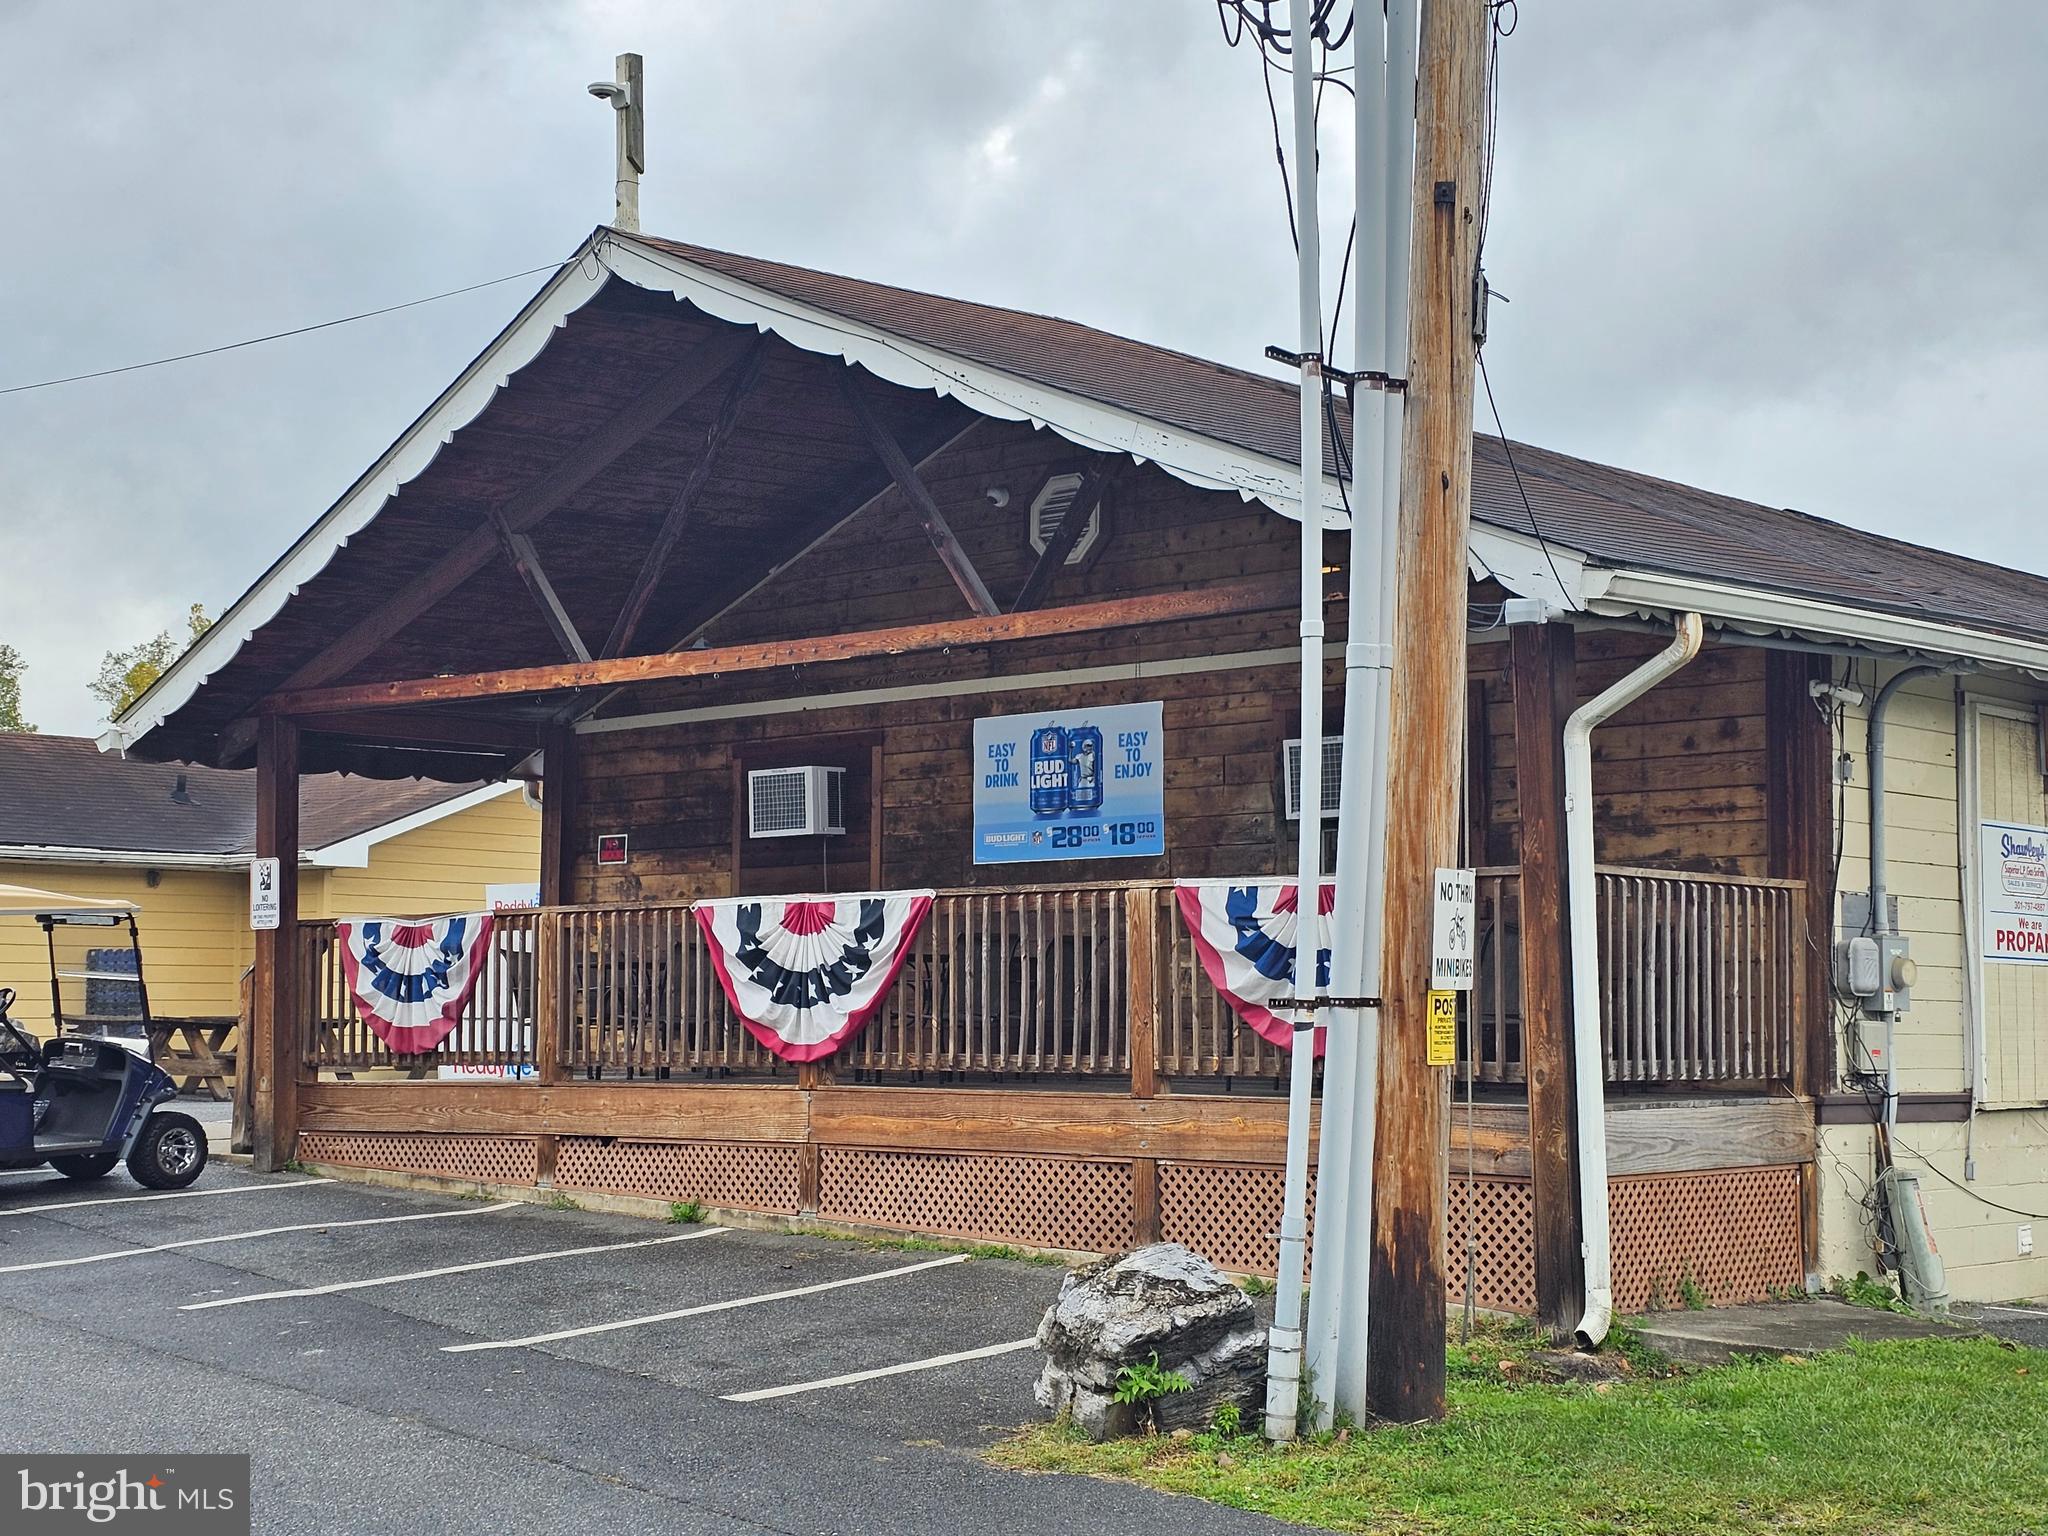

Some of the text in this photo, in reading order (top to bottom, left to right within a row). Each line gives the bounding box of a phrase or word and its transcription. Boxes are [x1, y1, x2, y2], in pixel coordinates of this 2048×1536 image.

[1042, 740, 1056, 751] NFL
[1118, 731, 1148, 748] EASY
[988, 742, 1016, 759] EASY
[1126, 747, 1141, 763] TO
[995, 758, 1009, 773] TO
[1034, 759, 1065, 775] BUD
[1114, 762, 1152, 779] ENJOY
[985, 772, 1019, 789] DRINK
[1031, 773, 1068, 789] LIGHT
[985, 832, 1026, 843] BUD LIGHT
[2001, 833, 2046, 862] Shawley's
[261, 894, 269, 903] NO
[1440, 882, 1473, 904] NO THRU
[252, 903, 277, 911] LOITERING
[2018, 917, 2042, 930] We are
[1435, 957, 1473, 978] MINIBIKES
